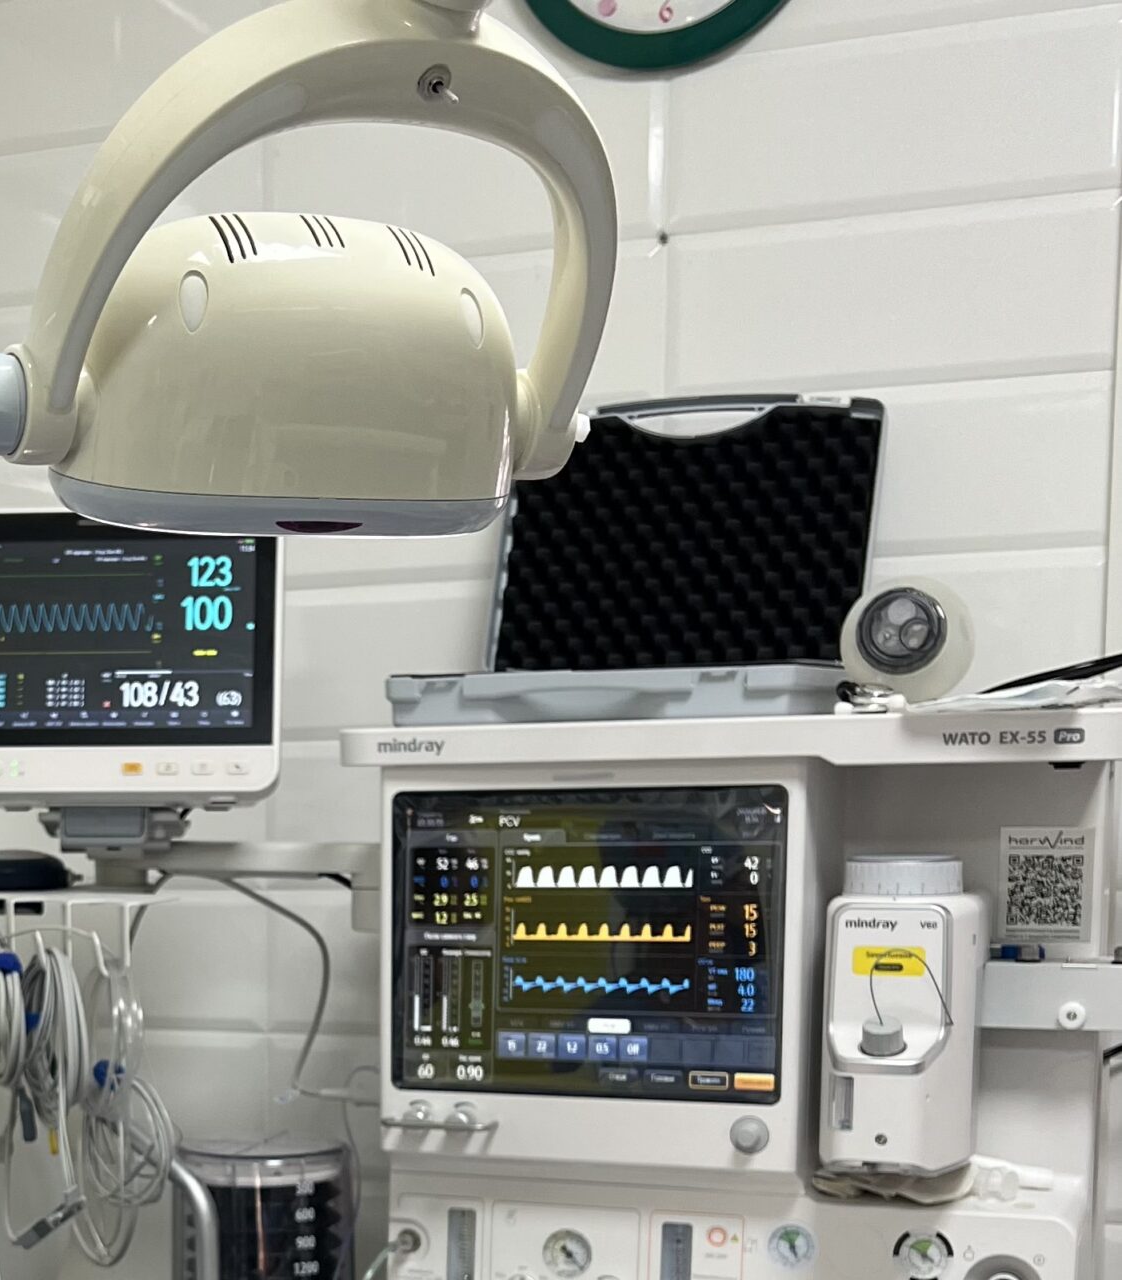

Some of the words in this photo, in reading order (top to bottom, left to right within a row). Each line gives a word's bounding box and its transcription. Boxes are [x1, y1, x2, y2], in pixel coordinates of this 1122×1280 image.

[187, 556, 232, 587] 123
[181, 595, 232, 631] 100
[119, 680, 200, 708] 108/43
[942, 731, 991, 746] WATO
[999, 730, 1047, 744] EX-55
[1058, 730, 1081, 742] Pro
[377, 737, 446, 757] mindray
[498, 814, 521, 828] PCV
[744, 855, 760, 871] 42
[750, 870, 759, 886] 0
[743, 903, 759, 921] 15
[743, 922, 758, 938] 15
[845, 917, 898, 931] mindray
[748, 940, 757, 957] 3
[734, 967, 756, 982] 180
[417, 1062, 435, 1079] 60
[456, 1063, 484, 1081] 0.90
[294, 1207, 315, 1223] 600
[295, 1235, 316, 1250] 900
[293, 1260, 319, 1276] 1200
